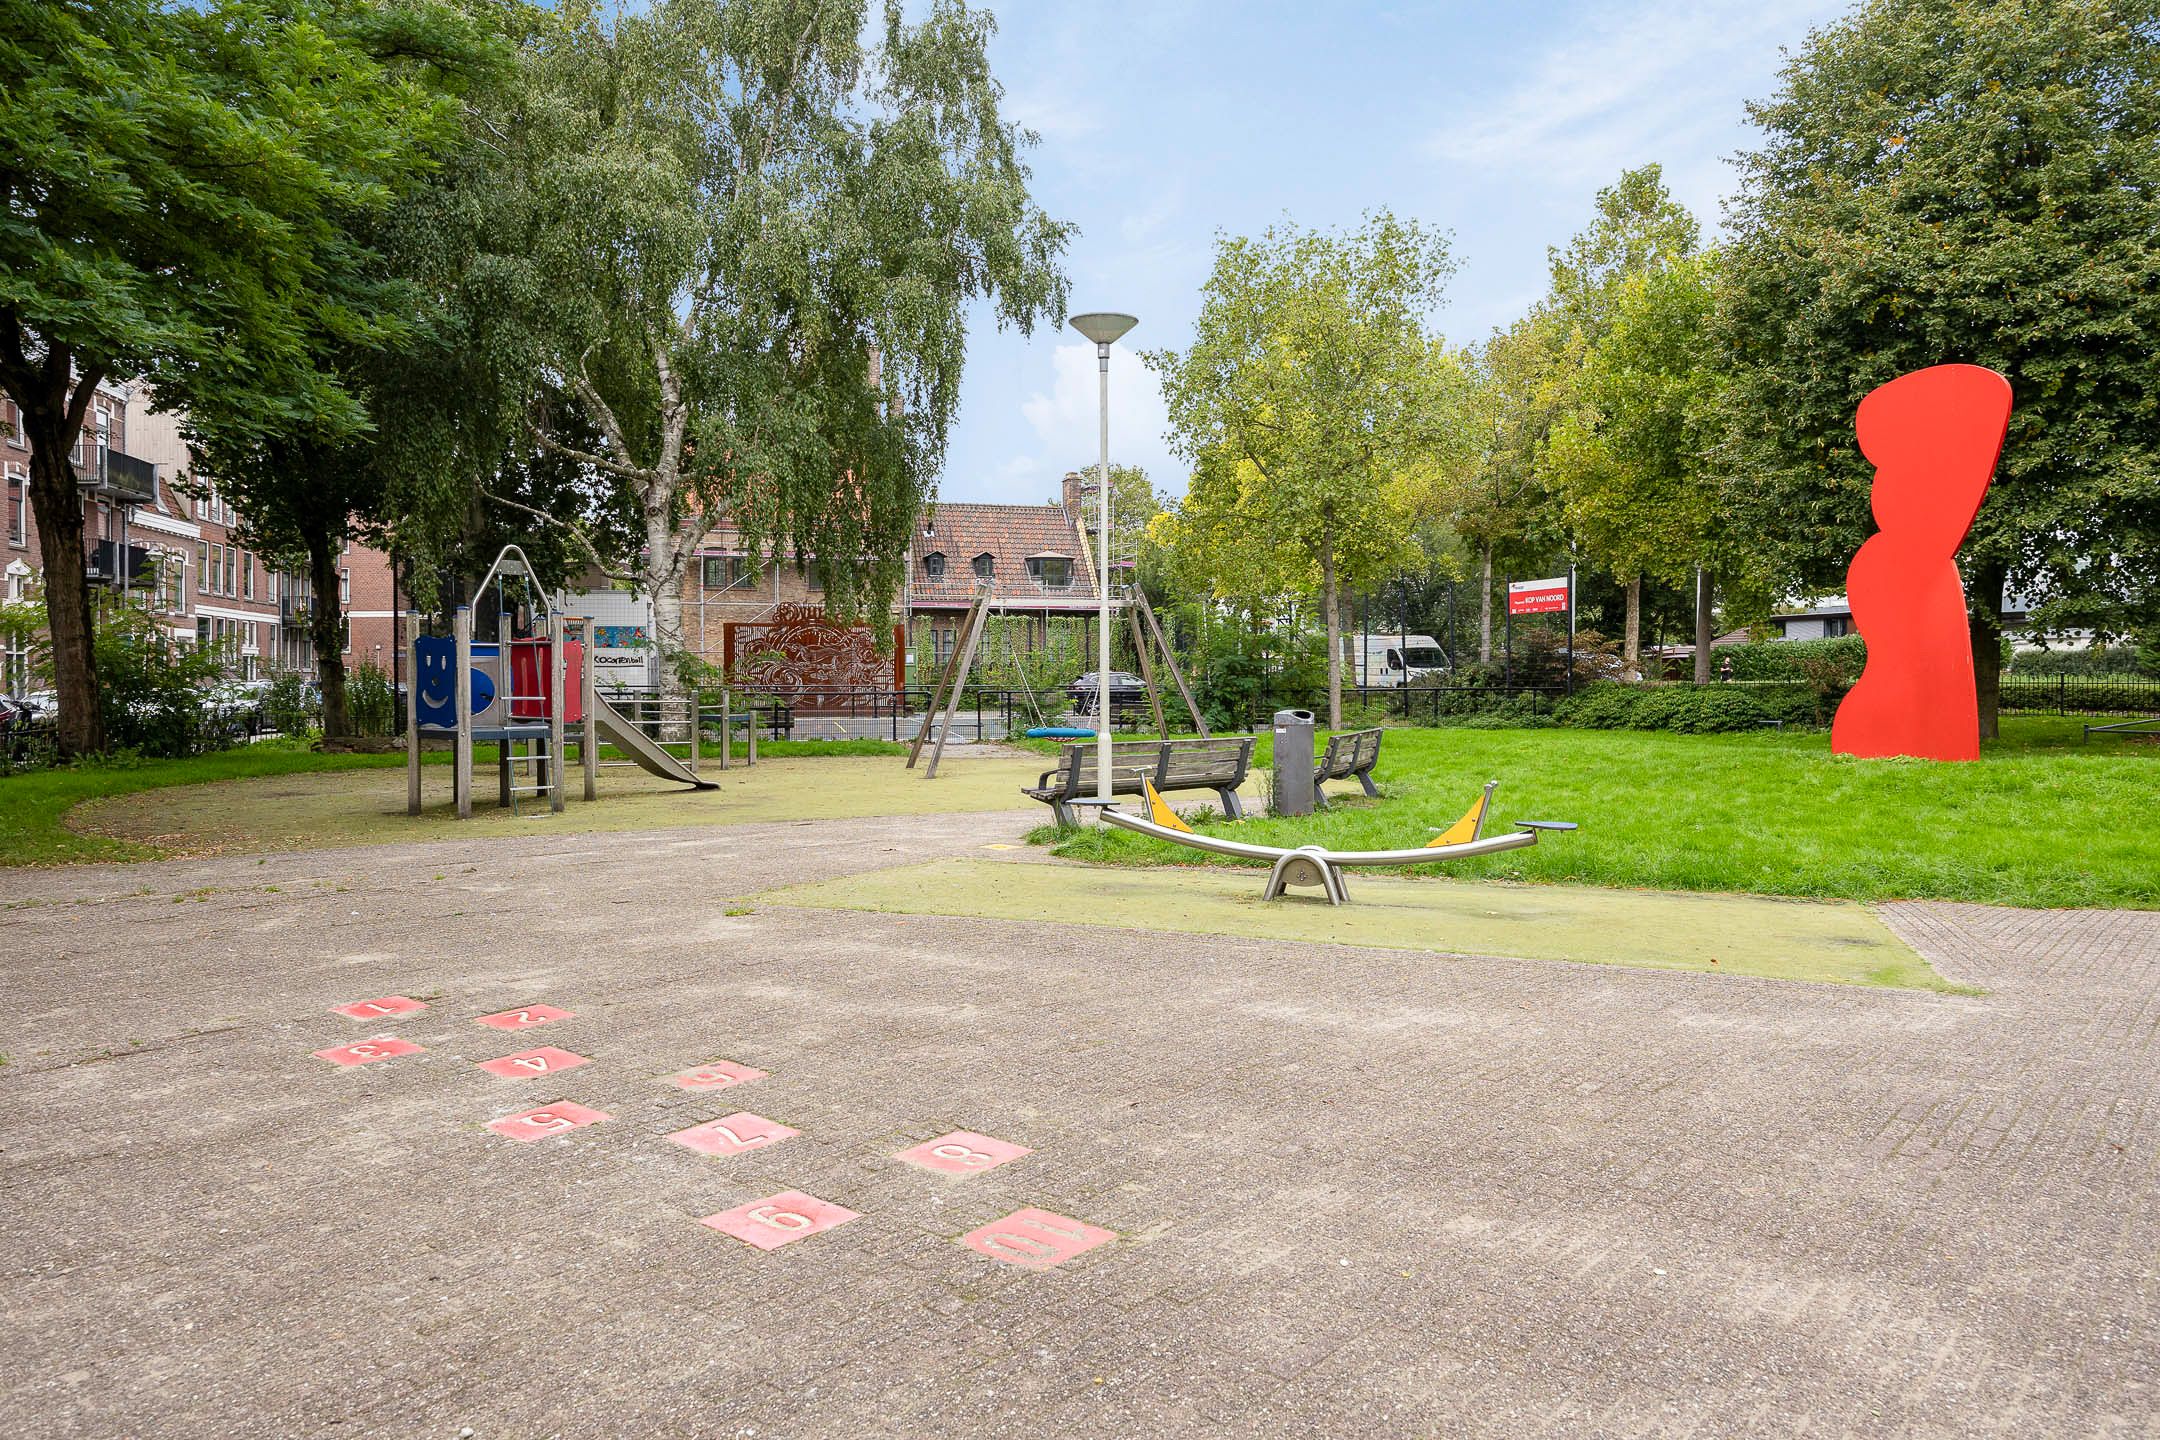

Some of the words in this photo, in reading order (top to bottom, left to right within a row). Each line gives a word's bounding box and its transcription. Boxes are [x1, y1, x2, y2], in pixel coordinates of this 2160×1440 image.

[504, 1011, 546, 1023] 2
[349, 1045, 391, 1058] 3
[511, 1056, 550, 1071] 4
[520, 1113, 574, 1130] 5
[713, 1125, 768, 1147] 7
[931, 1144, 992, 1166] 8
